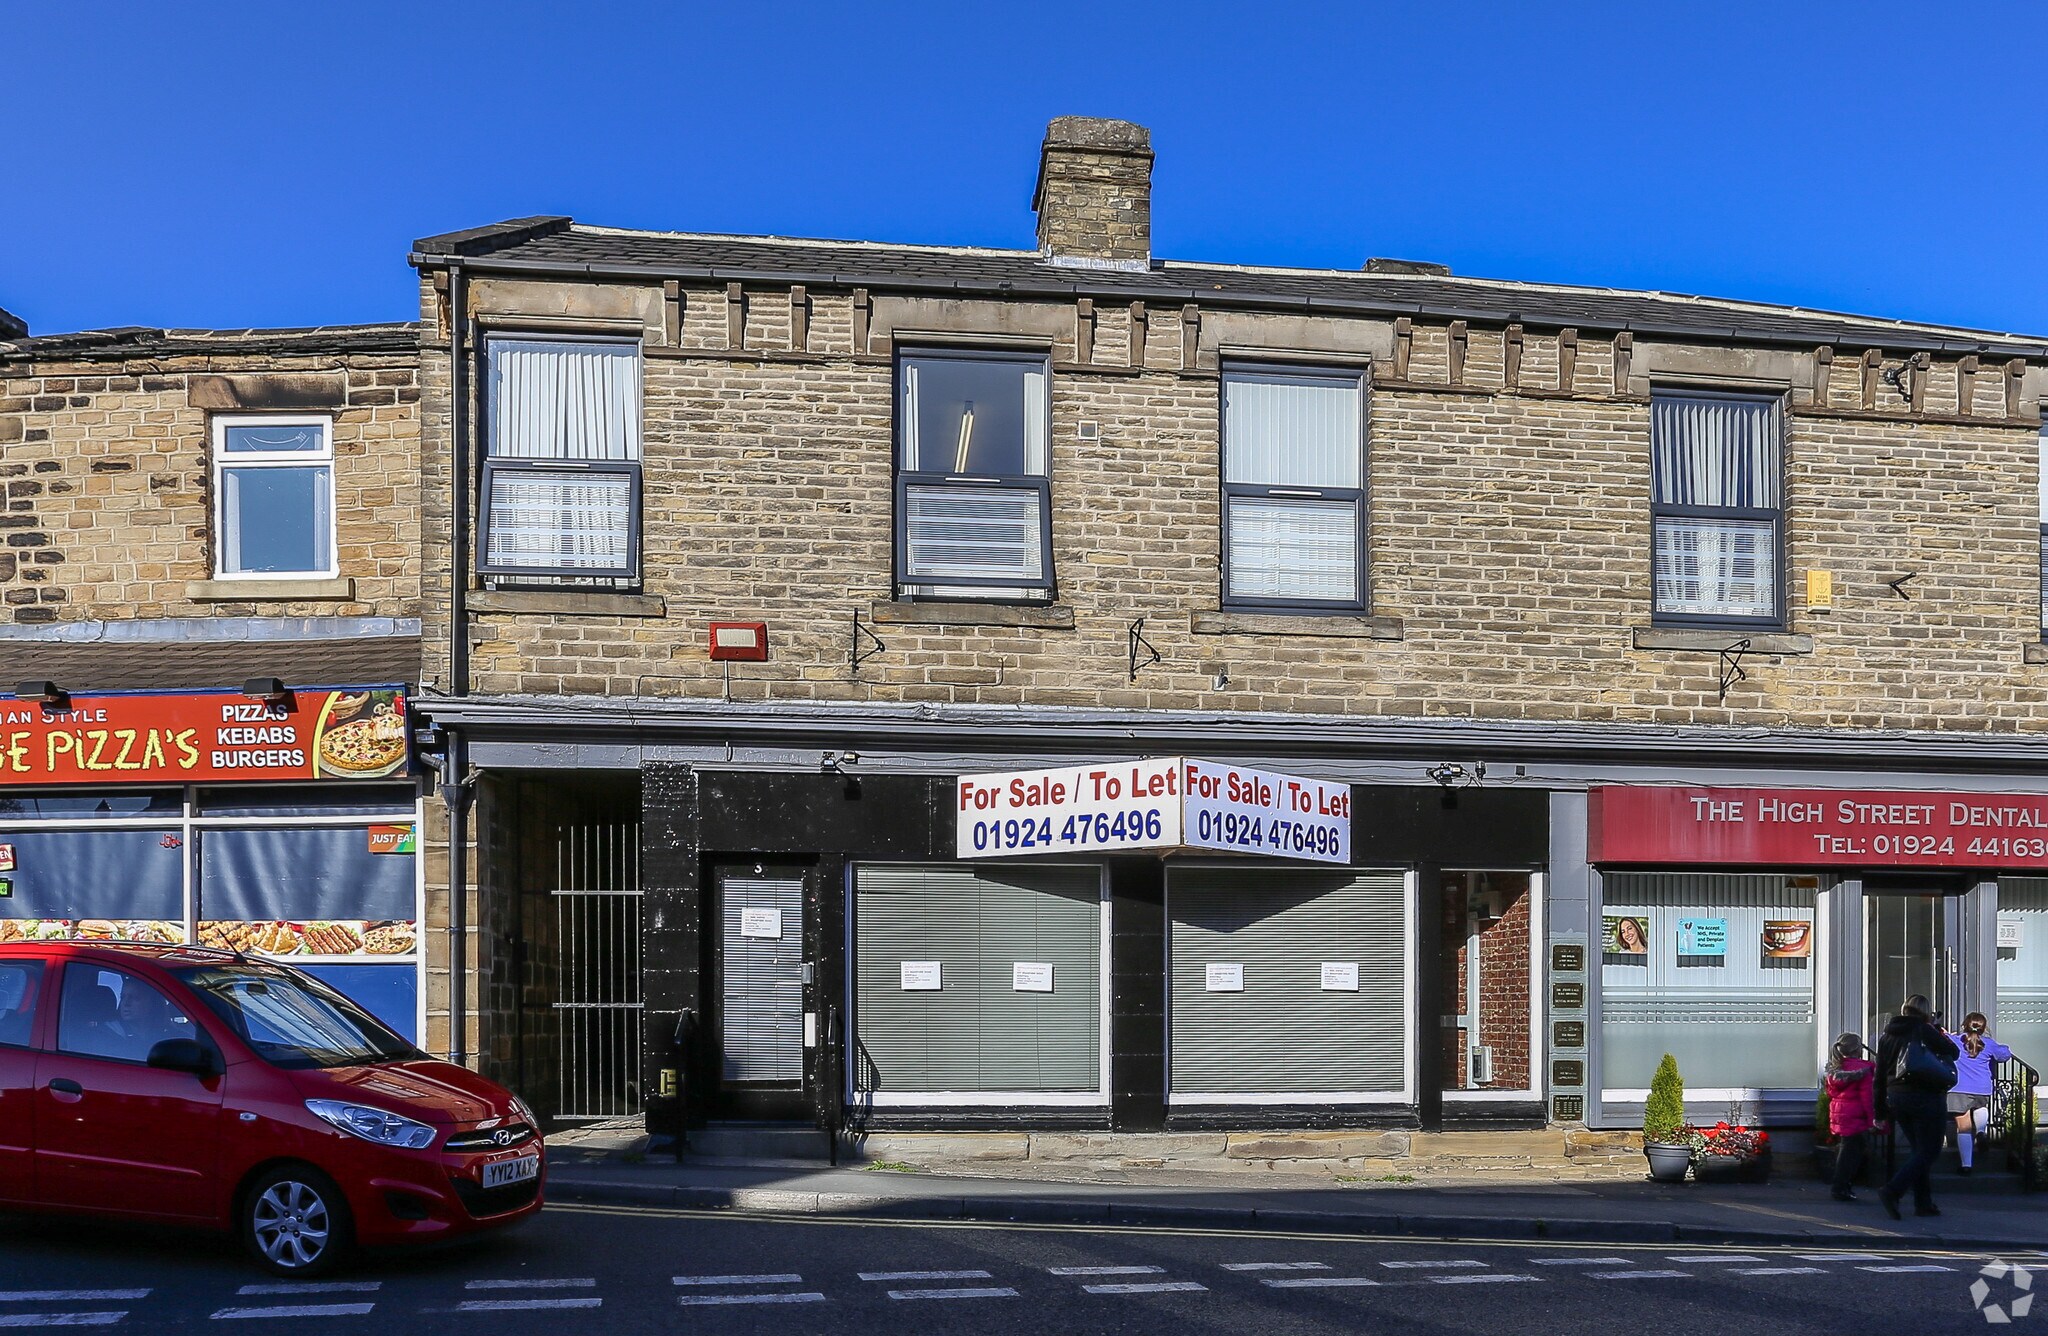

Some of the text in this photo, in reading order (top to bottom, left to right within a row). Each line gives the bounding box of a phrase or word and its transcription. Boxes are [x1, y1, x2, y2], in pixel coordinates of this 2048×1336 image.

[41, 709, 107, 723] STYLE
[222, 704, 288, 722] PIZZAS
[217, 726, 296, 745] KEBABS
[0, 731, 32, 772] E
[211, 749, 304, 768] BURGERS
[960, 782, 1001, 811] For
[1009, 776, 1066, 808] Sale
[1089, 771, 1122, 801] To
[1131, 766, 1177, 798] Let
[1186, 765, 1221, 799] For
[1227, 772, 1271, 807] Sale
[1288, 782, 1312, 813] To
[1318, 786, 1349, 818] Let
[1689, 796, 2048, 828] THE HIGH STREET DENTAL
[371, 834, 416, 845] JUST EAT
[973, 809, 1162, 850] 01924 476496
[1199, 810, 1340, 856] 01924 476496
[1813, 834, 2048, 857] TEL: 01924 44163
[490, 1157, 533, 1183] YY12 XAX
